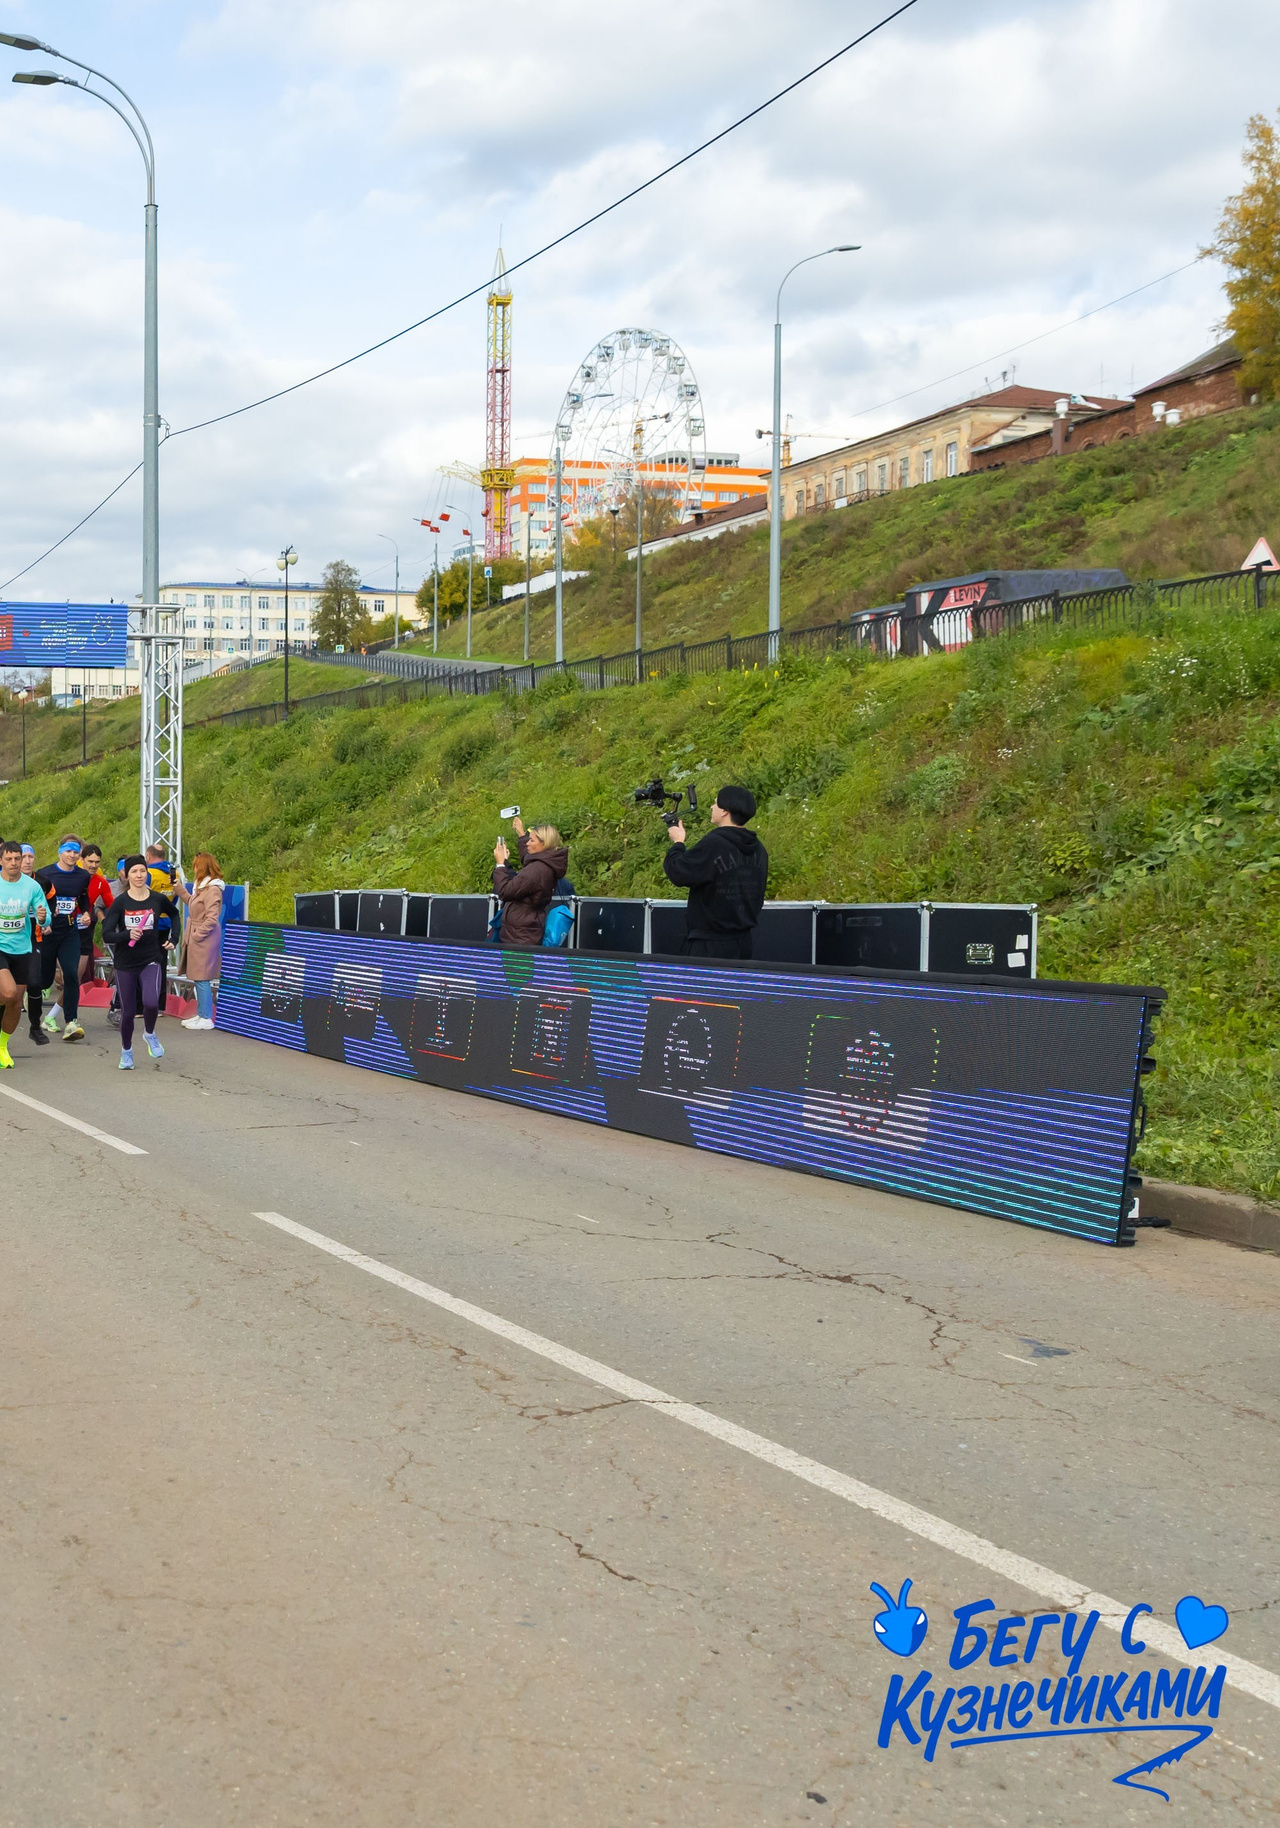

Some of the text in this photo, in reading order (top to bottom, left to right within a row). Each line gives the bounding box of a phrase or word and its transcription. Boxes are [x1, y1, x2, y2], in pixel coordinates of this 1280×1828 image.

[954, 585, 981, 602] LEVIN
[3, 920, 21, 928] 516
[130, 916, 144, 924] 19
